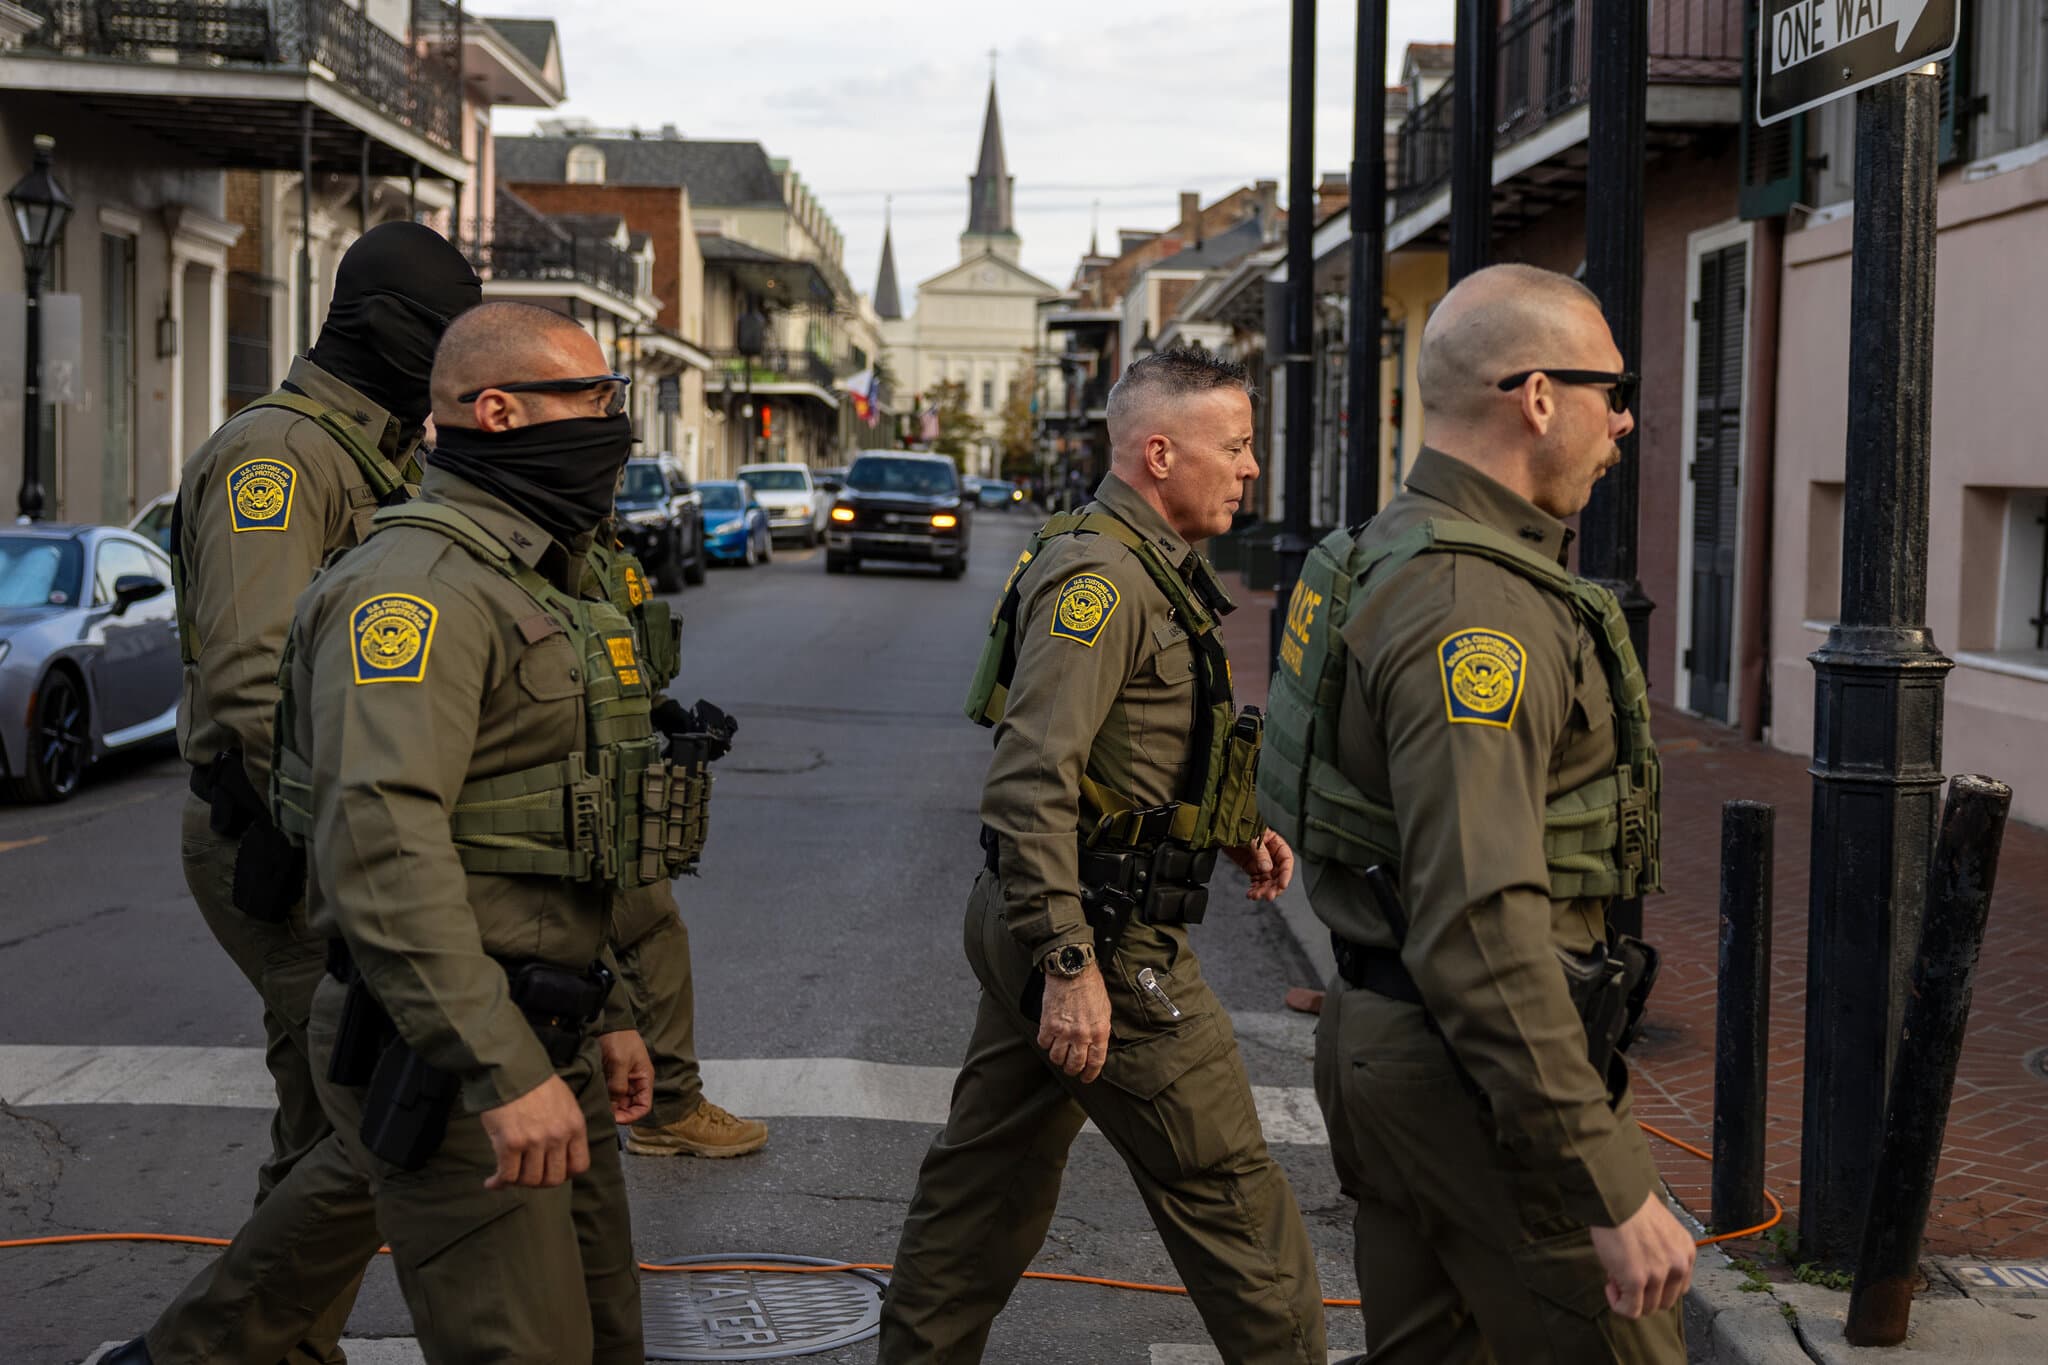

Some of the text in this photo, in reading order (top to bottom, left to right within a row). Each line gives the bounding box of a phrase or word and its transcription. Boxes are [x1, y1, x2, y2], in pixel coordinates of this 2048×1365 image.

[1778, 0, 1825, 67] ONE
[233, 470, 288, 491] BORDER PROTECTION
[252, 464, 281, 473] CUSTOMS
[280, 471, 290, 479] AND
[1062, 584, 1109, 608] BORDER PROTECTION
[1084, 578, 1109, 593] CUSTOMS
